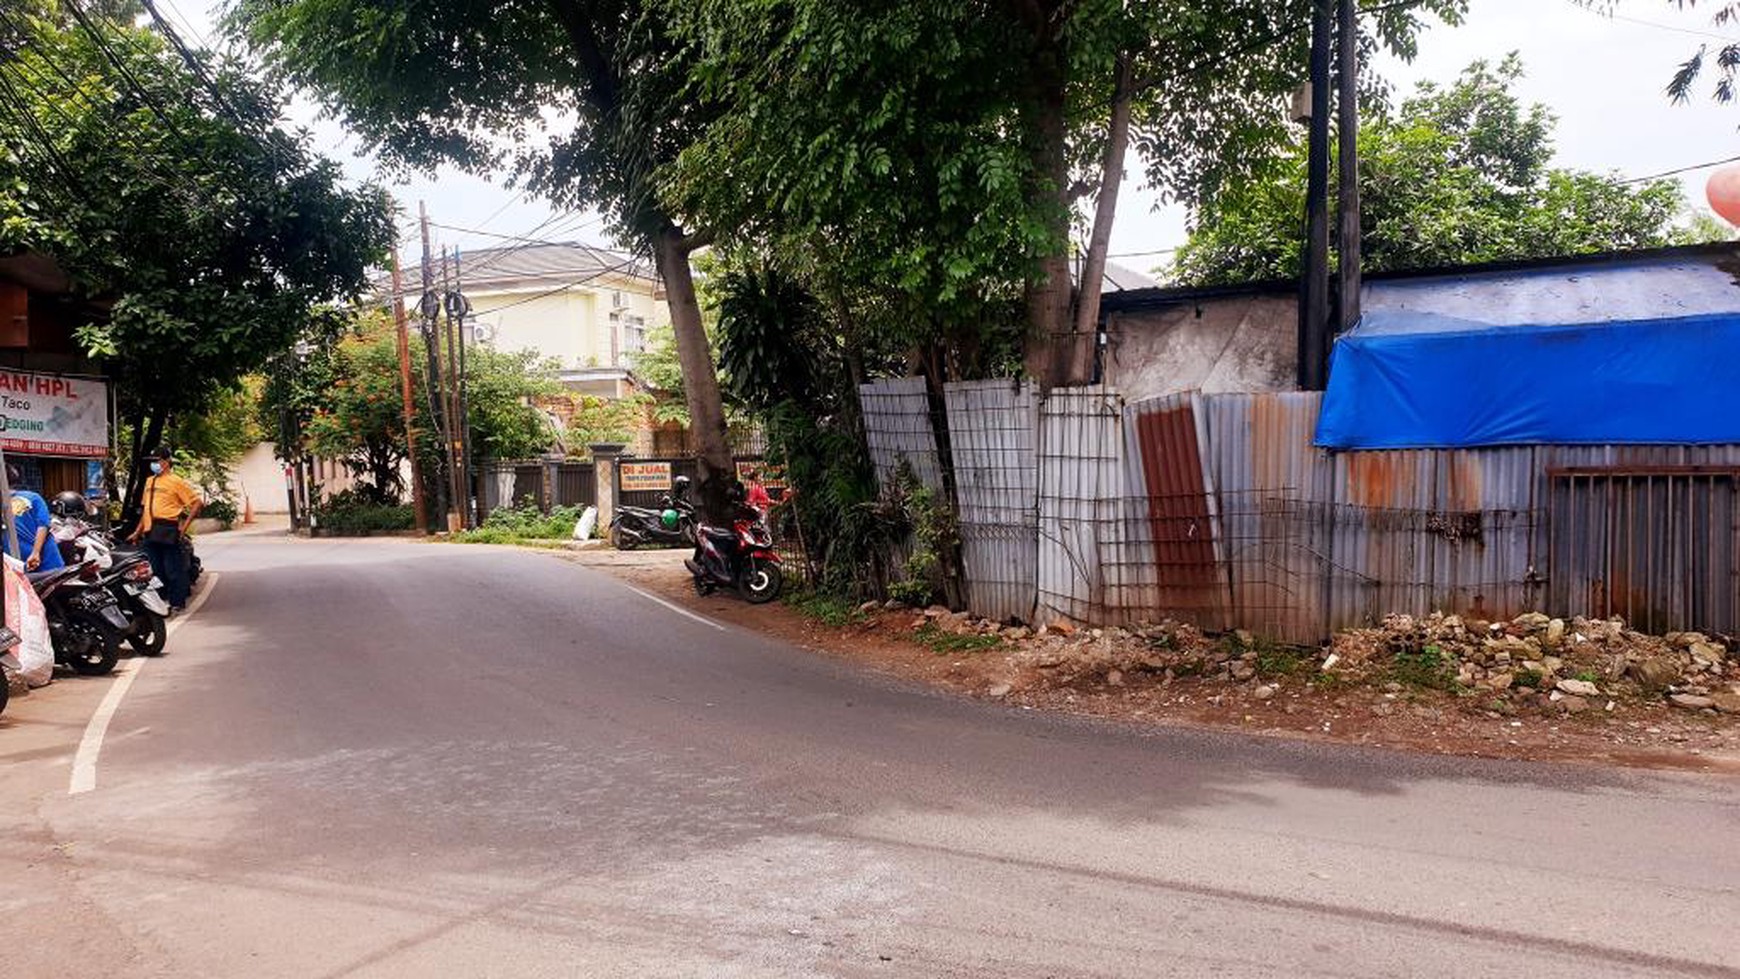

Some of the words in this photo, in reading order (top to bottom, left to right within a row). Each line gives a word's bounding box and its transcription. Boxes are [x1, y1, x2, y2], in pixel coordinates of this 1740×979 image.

[36, 377, 77, 399] HPL
[2, 395, 31, 410] Taco
[638, 464, 669, 474] JUAL
